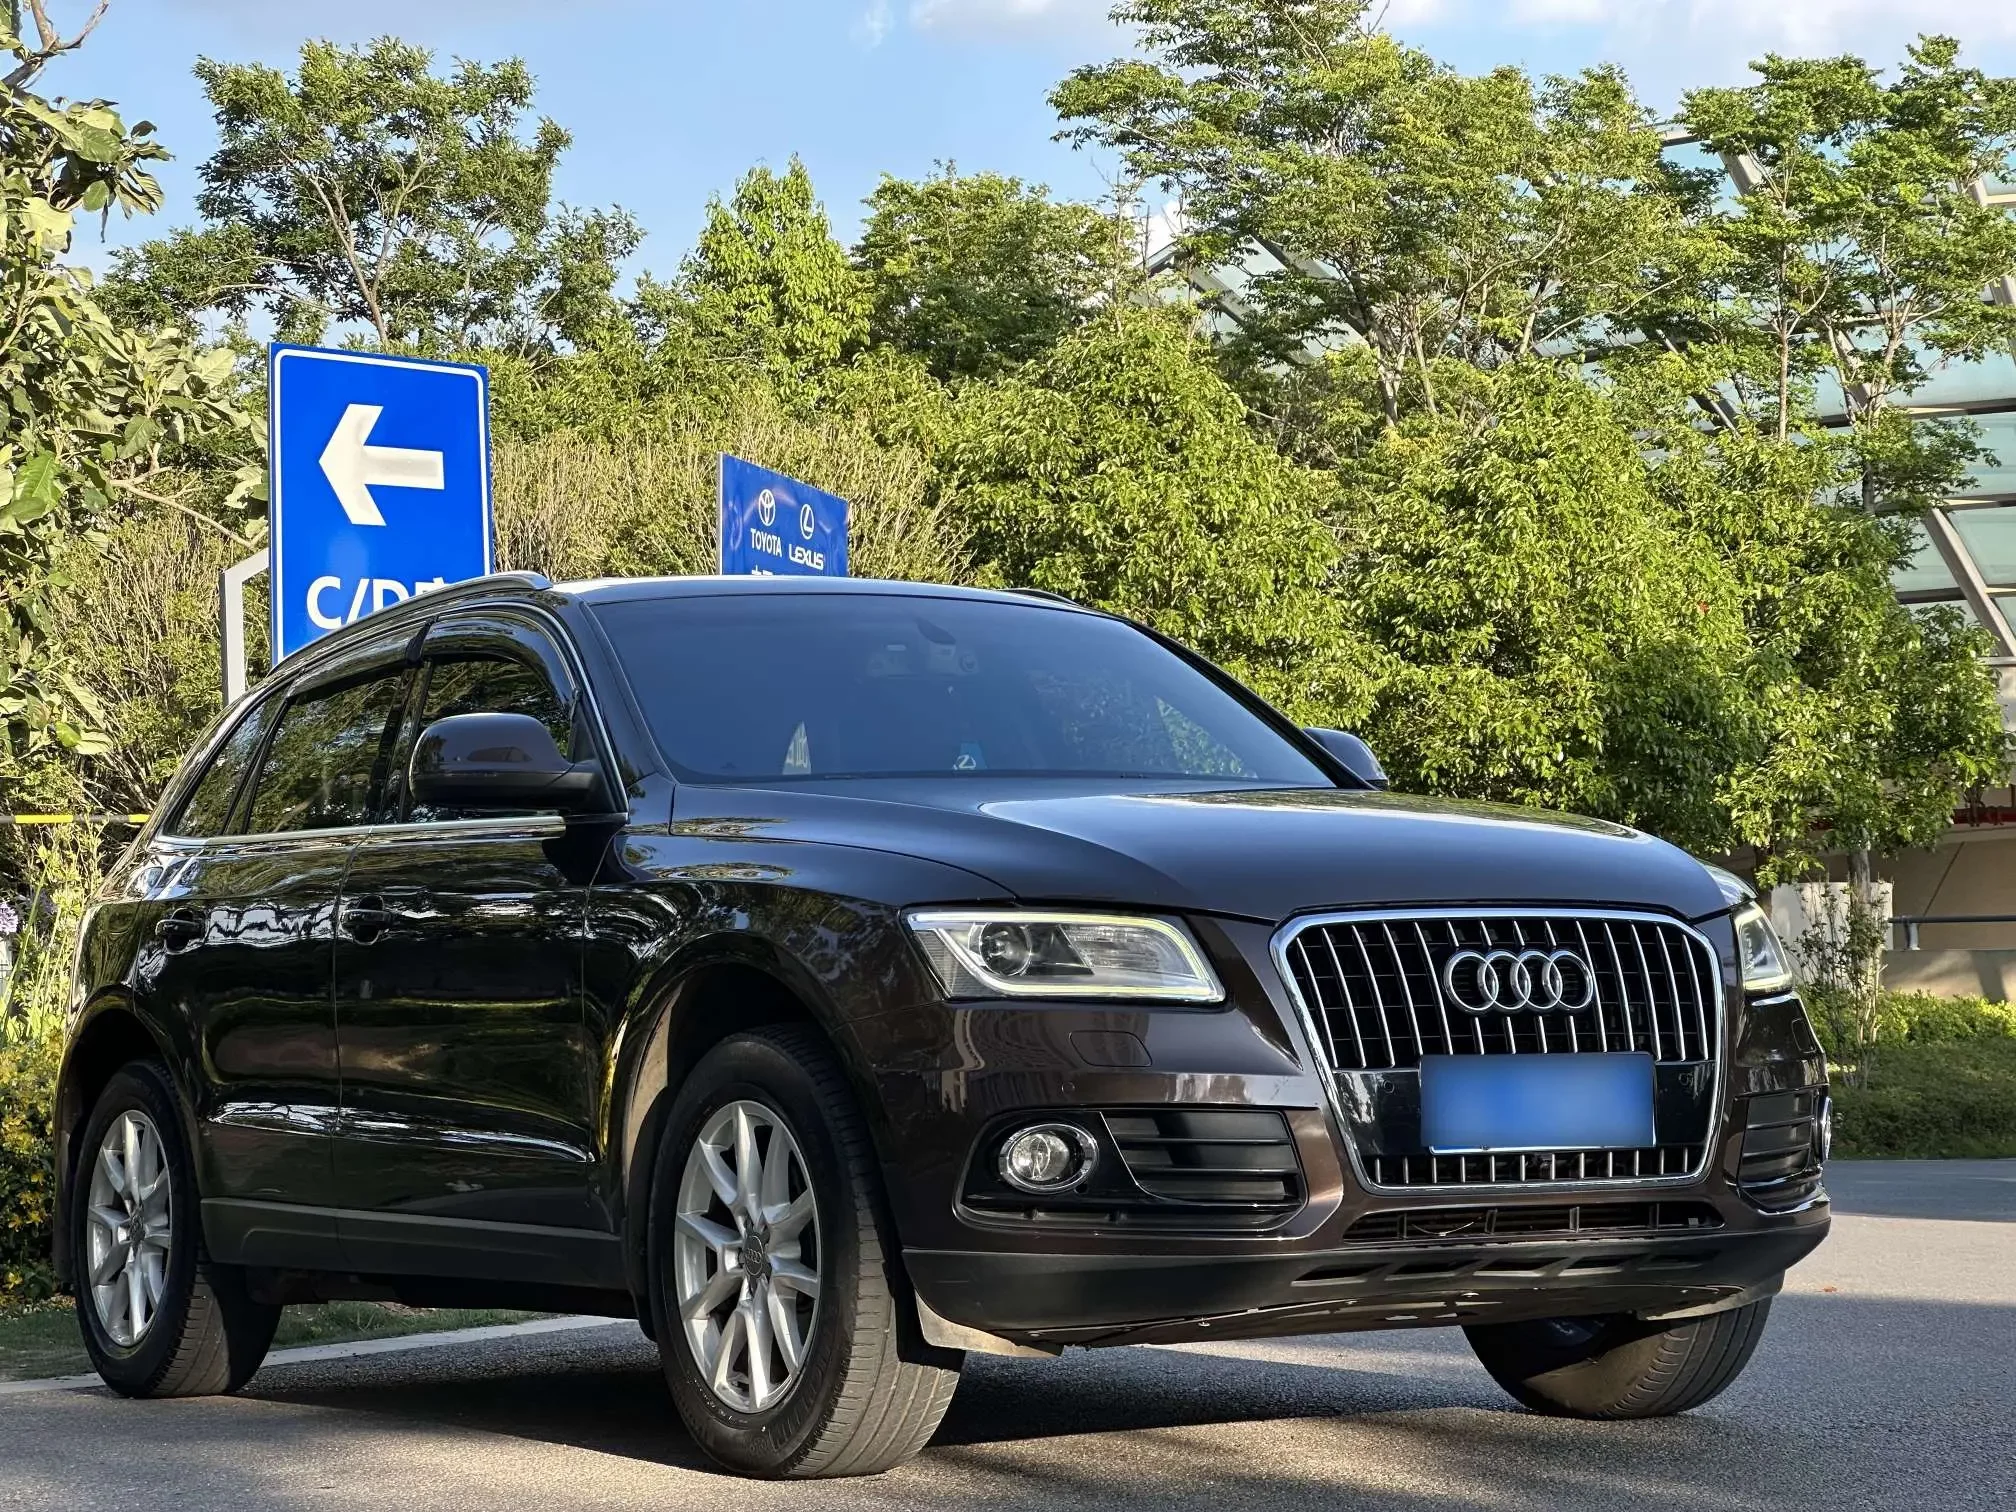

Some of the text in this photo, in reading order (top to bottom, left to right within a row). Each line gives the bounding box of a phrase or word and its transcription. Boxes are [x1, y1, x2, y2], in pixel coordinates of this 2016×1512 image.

[750, 528, 782, 557] TOYOTA
[789, 543, 824, 570] LEXUS
[306, 575, 450, 629] C/D
